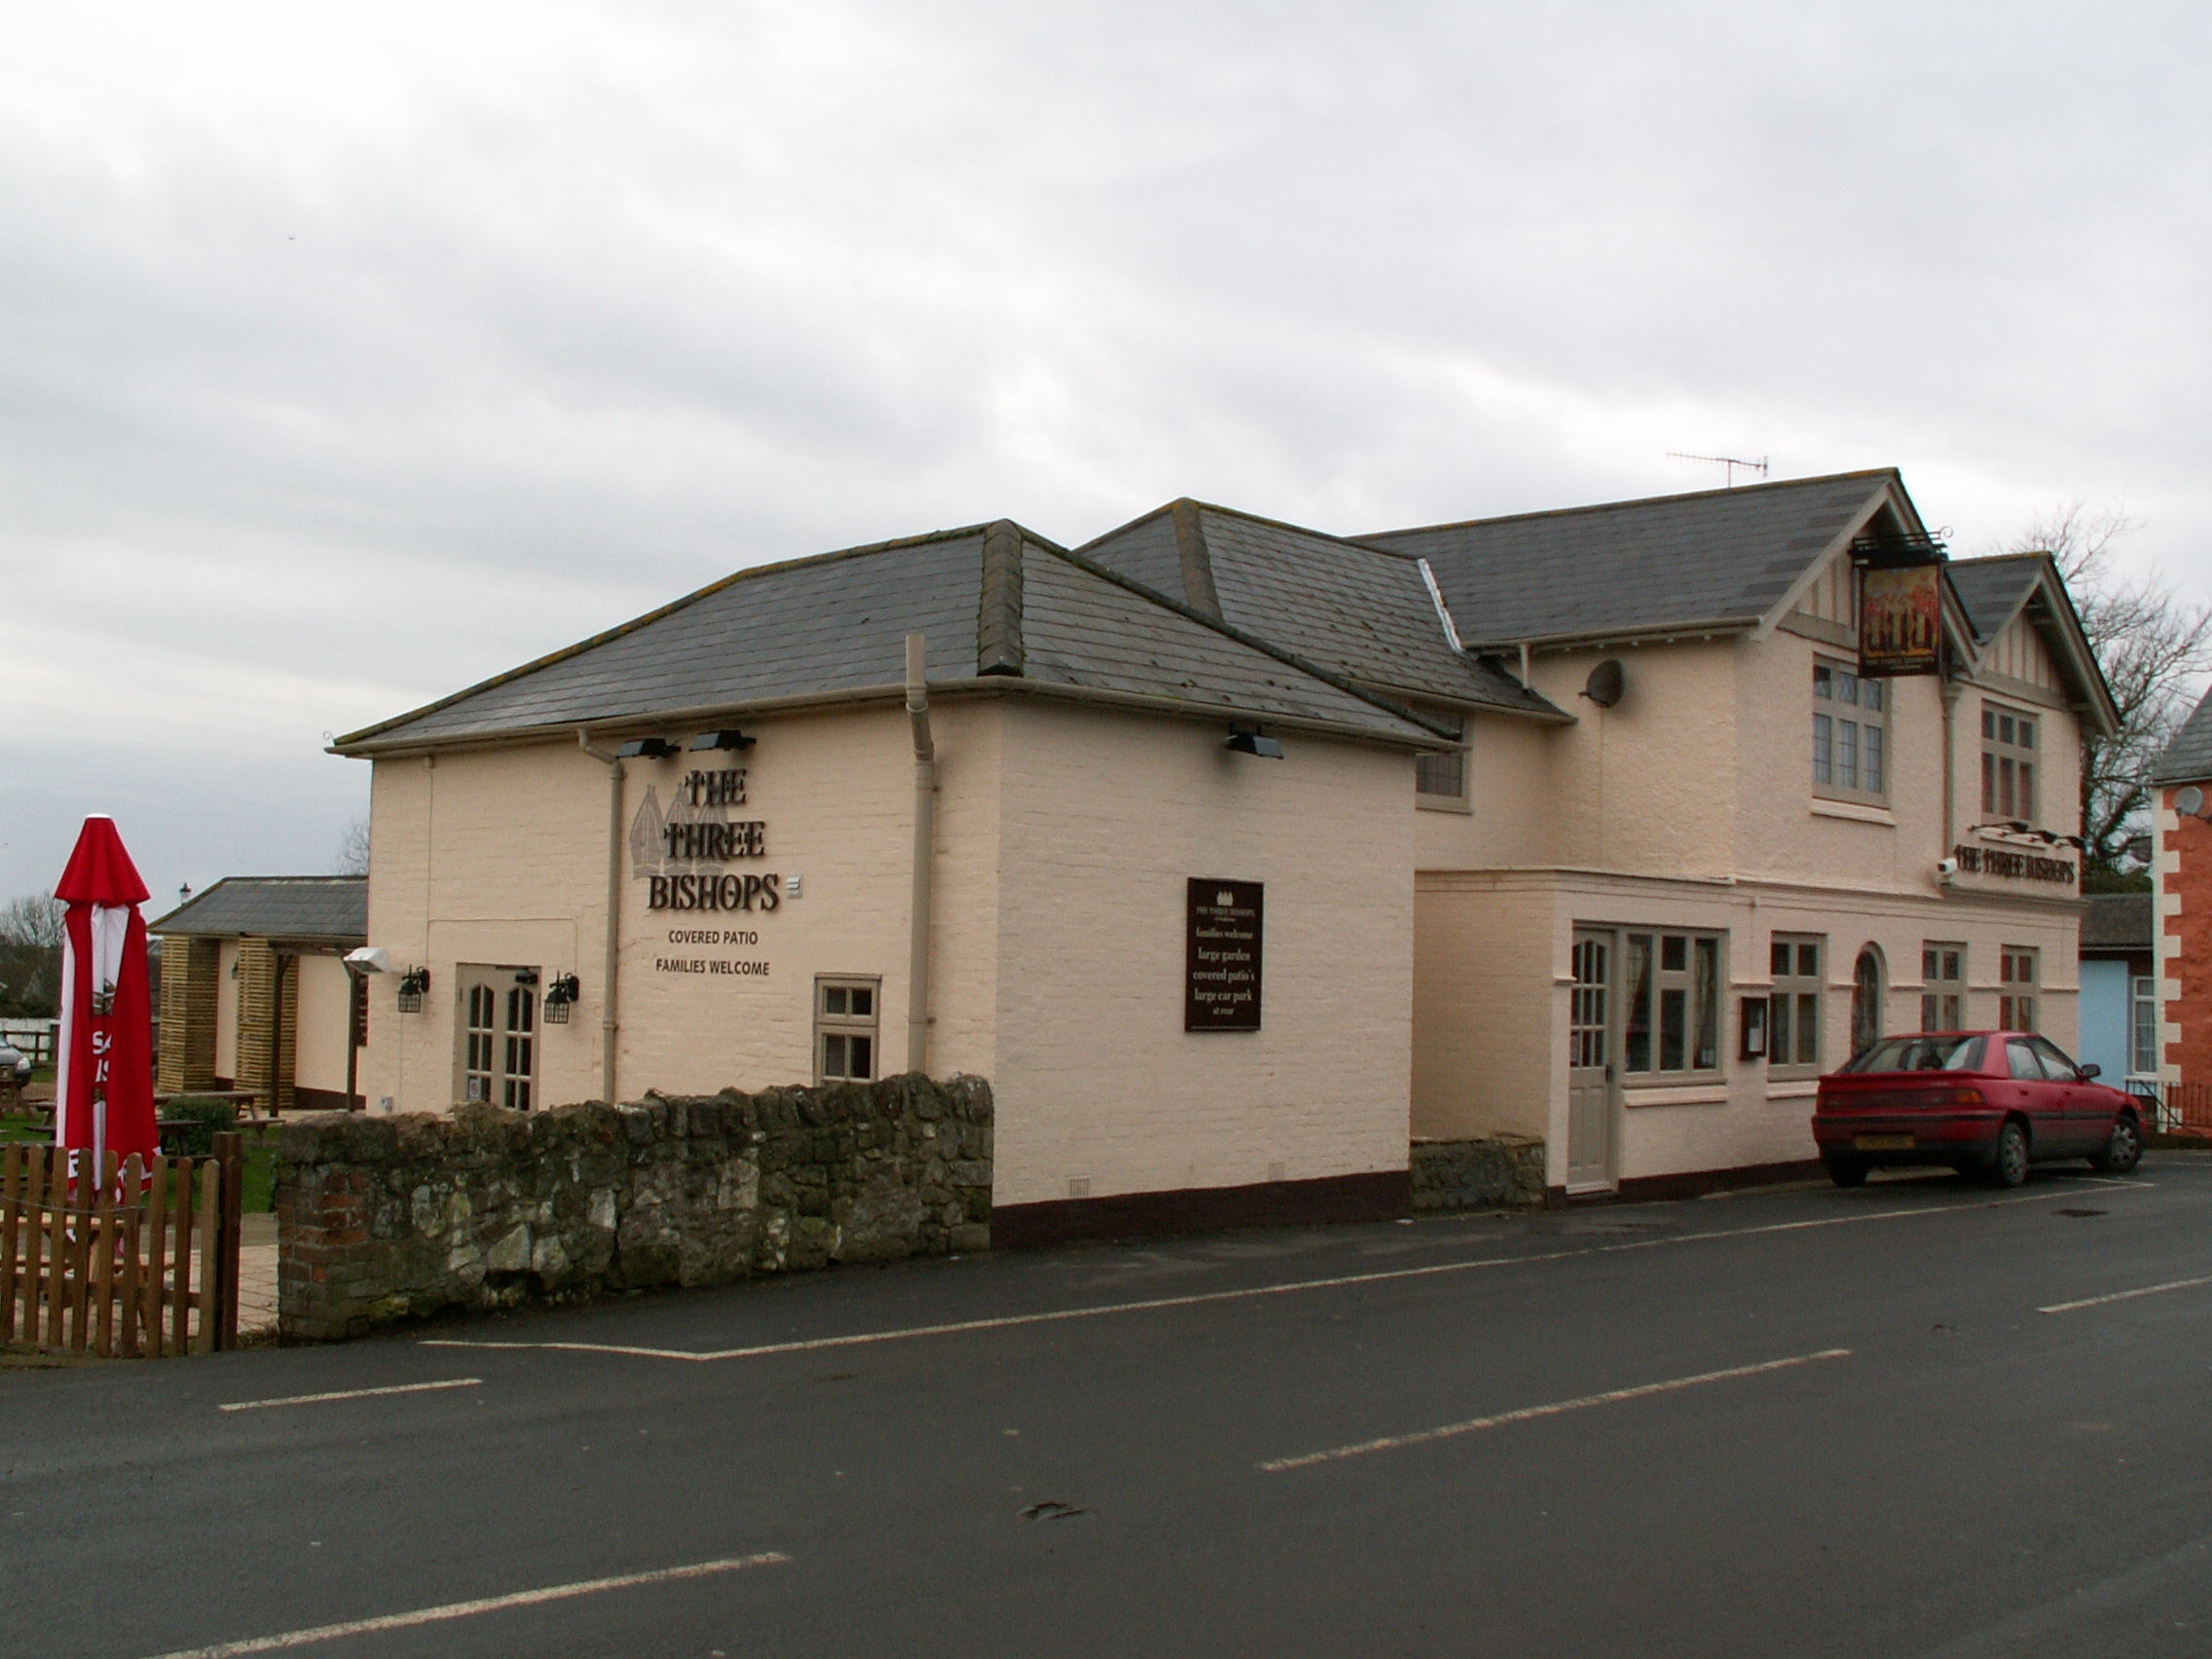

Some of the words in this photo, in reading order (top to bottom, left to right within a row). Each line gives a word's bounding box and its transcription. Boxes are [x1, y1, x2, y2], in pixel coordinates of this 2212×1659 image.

[684, 768, 748, 806] THE
[663, 821, 765, 861] THREE
[1953, 844, 1981, 872] THE
[647, 872, 780, 912] BISHOPS
[668, 930, 720, 945] COVERED
[723, 931, 758, 945] PATIO
[1196, 927, 1224, 939] families
[1224, 929, 1254, 940] welcome
[1198, 946, 1220, 963] large
[1222, 948, 1251, 963] garden
[655, 958, 706, 975] FAMILIES
[709, 960, 770, 976] WELCOME
[1193, 968, 1227, 981] covered
[1228, 969, 1255, 984] patio's
[1195, 987, 1217, 1004] large
[1218, 990, 1232, 1002] car
[1233, 988, 1253, 1004] park
